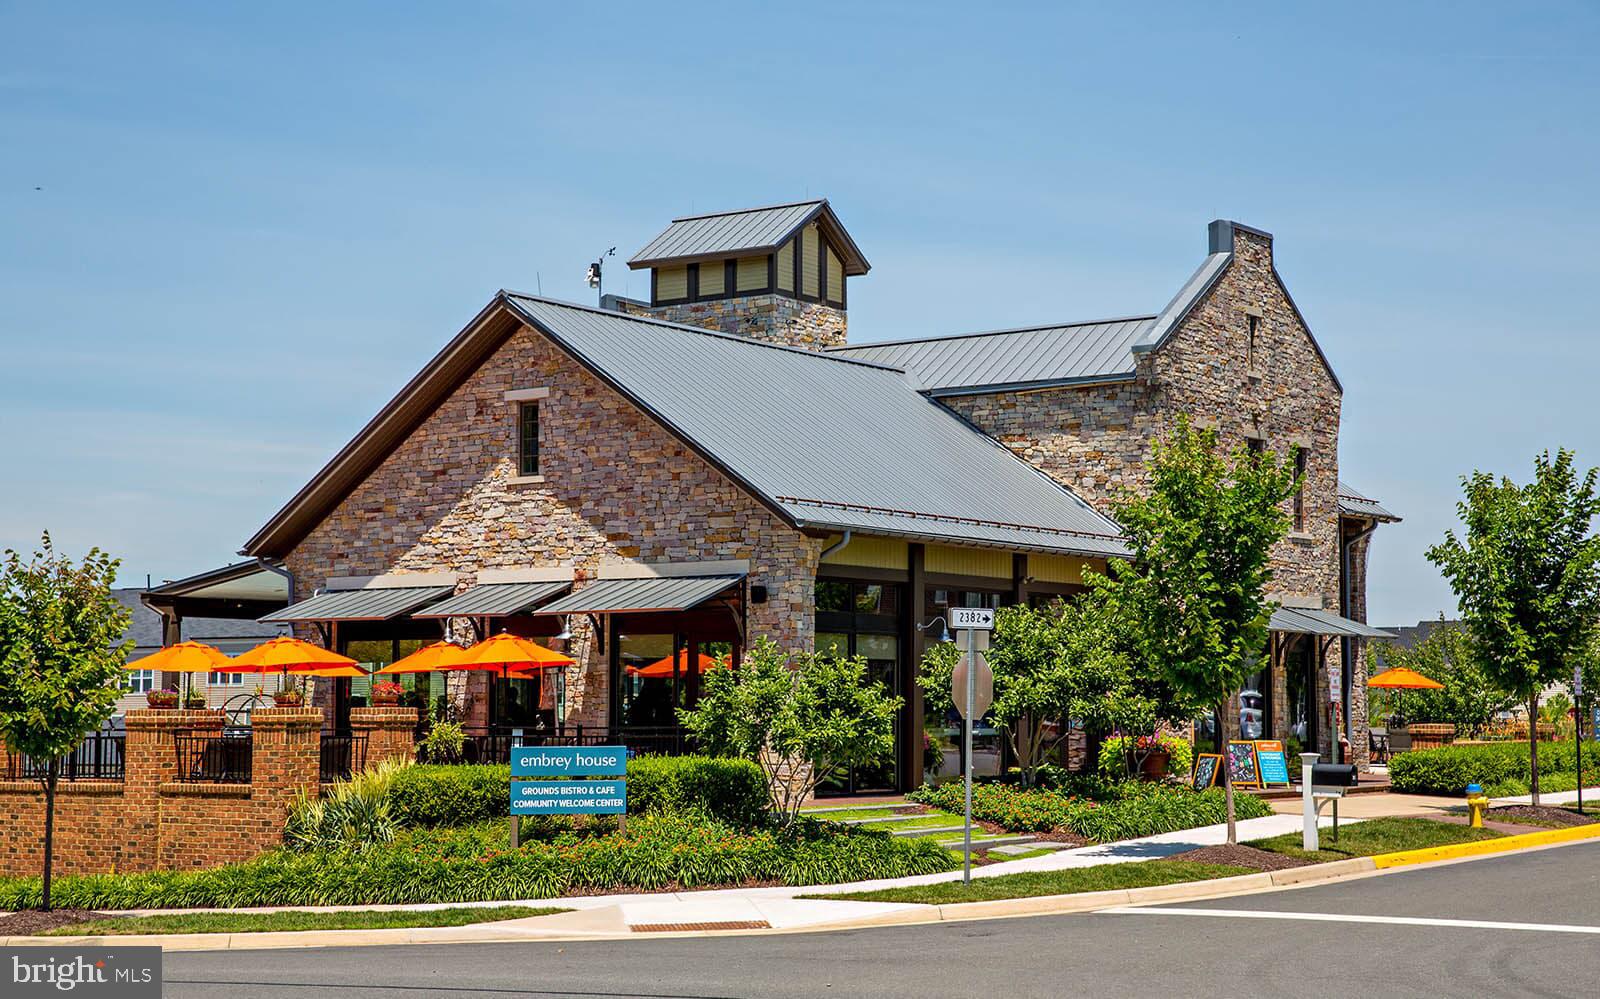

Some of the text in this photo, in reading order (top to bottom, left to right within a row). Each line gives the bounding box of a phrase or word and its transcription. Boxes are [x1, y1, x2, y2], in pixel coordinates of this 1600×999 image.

[959, 612, 981, 623] 2382
[520, 752, 617, 770] embrey house
[521, 786, 616, 796] GROUNDS BISTRO & CAFE
[513, 798, 624, 809] COMMUNITY WELCOME CENTER
